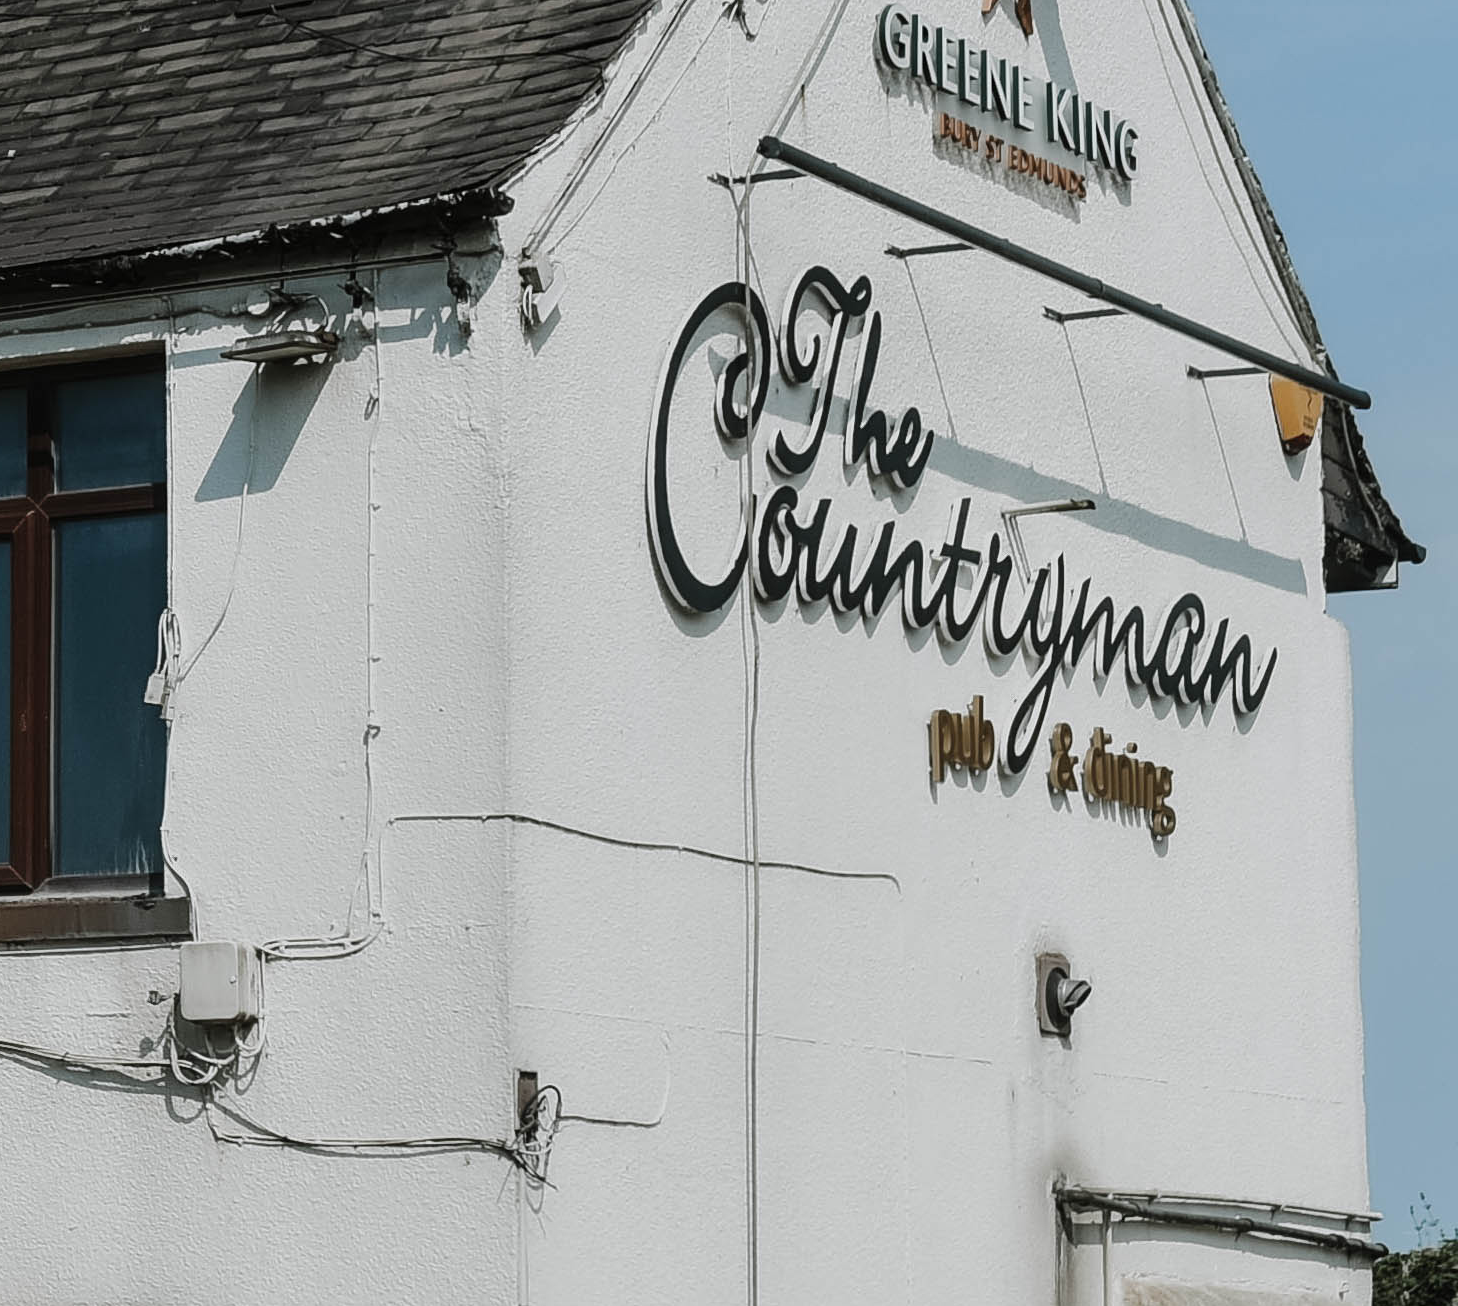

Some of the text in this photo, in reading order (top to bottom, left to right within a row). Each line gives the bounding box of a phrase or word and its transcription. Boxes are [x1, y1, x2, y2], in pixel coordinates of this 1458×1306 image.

[878, 3, 1139, 181] GREENE KING
[939, 111, 1087, 200] BURY ST EDMUNDS
[772, 265, 934, 489] The
[646, 280, 1278, 776] Countryman
[930, 695, 1176, 836] pub & dining
